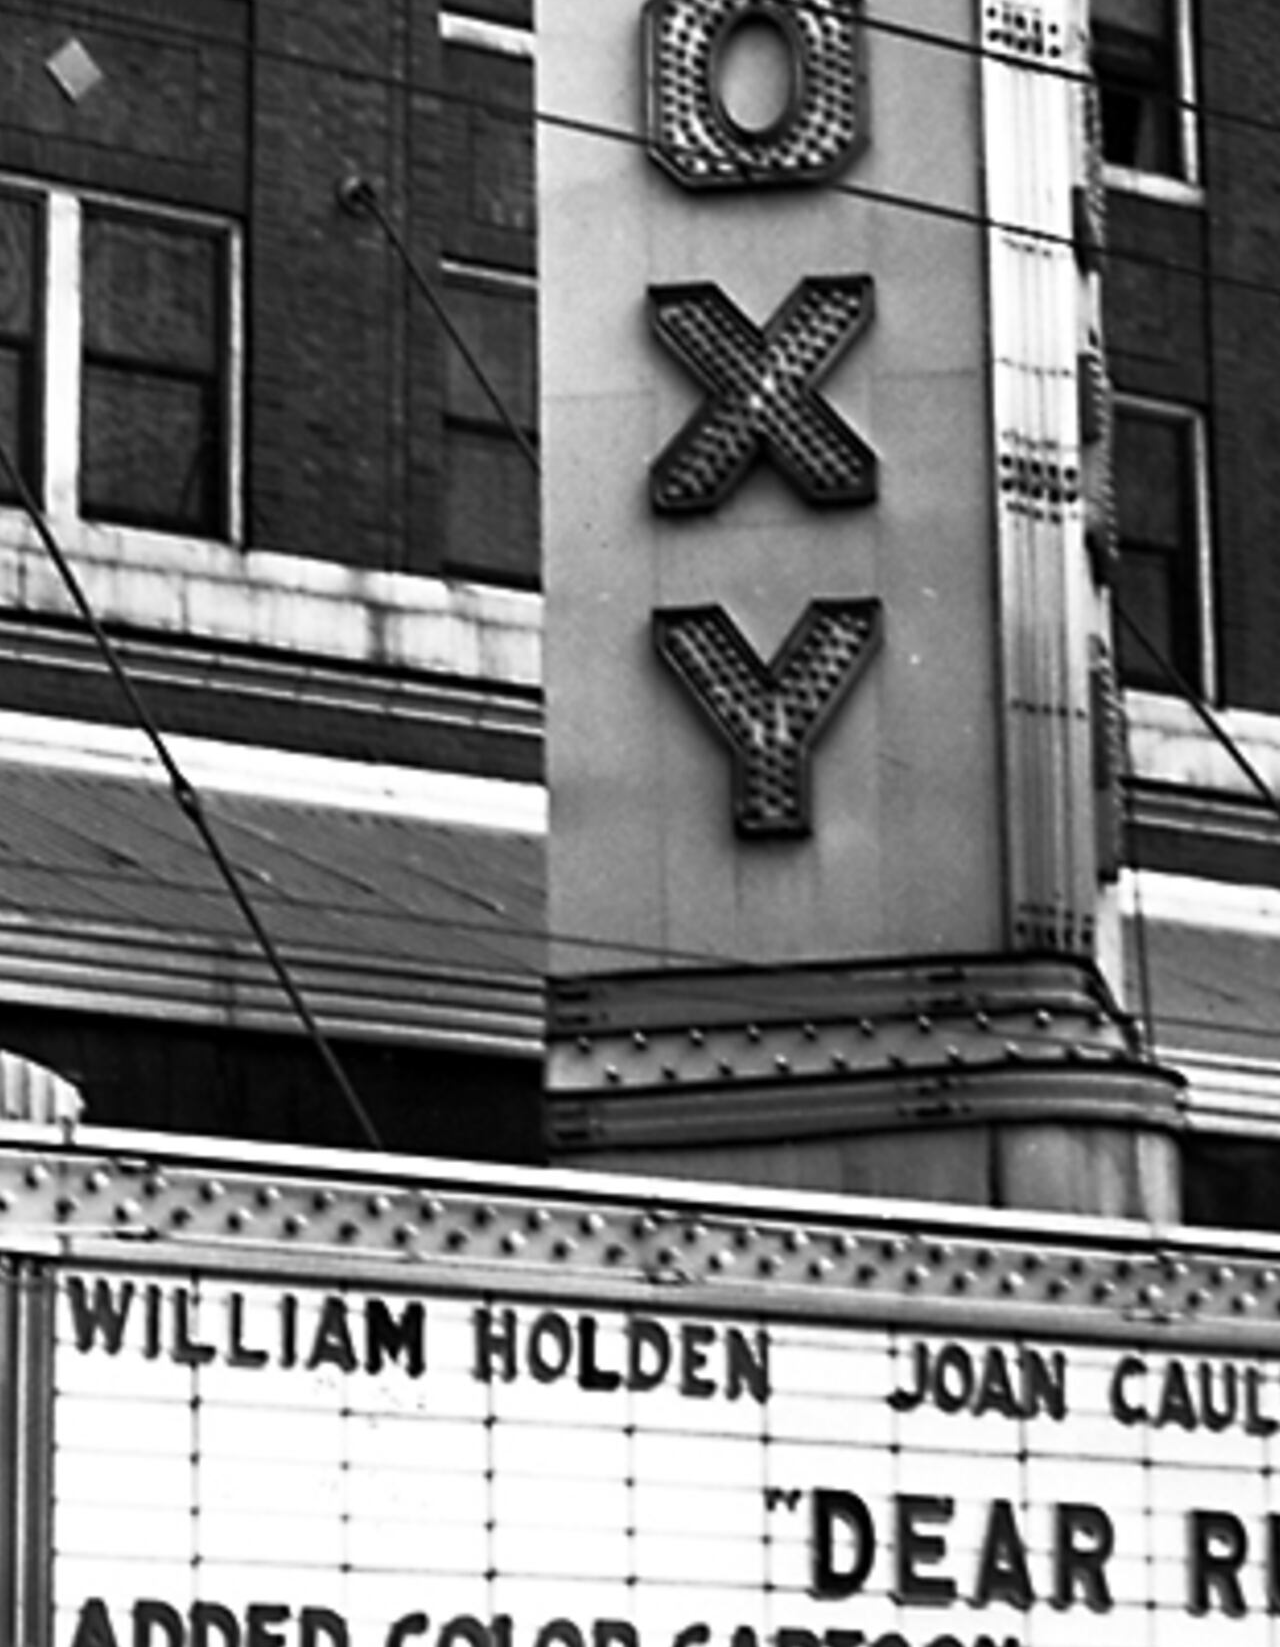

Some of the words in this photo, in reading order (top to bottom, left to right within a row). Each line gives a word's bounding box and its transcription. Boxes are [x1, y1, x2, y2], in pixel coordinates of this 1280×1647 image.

[66, 1276, 426, 1379] WILLIAM
[473, 1306, 772, 1405] HOLDEN
[885, 1341, 1070, 1421] JOAN
